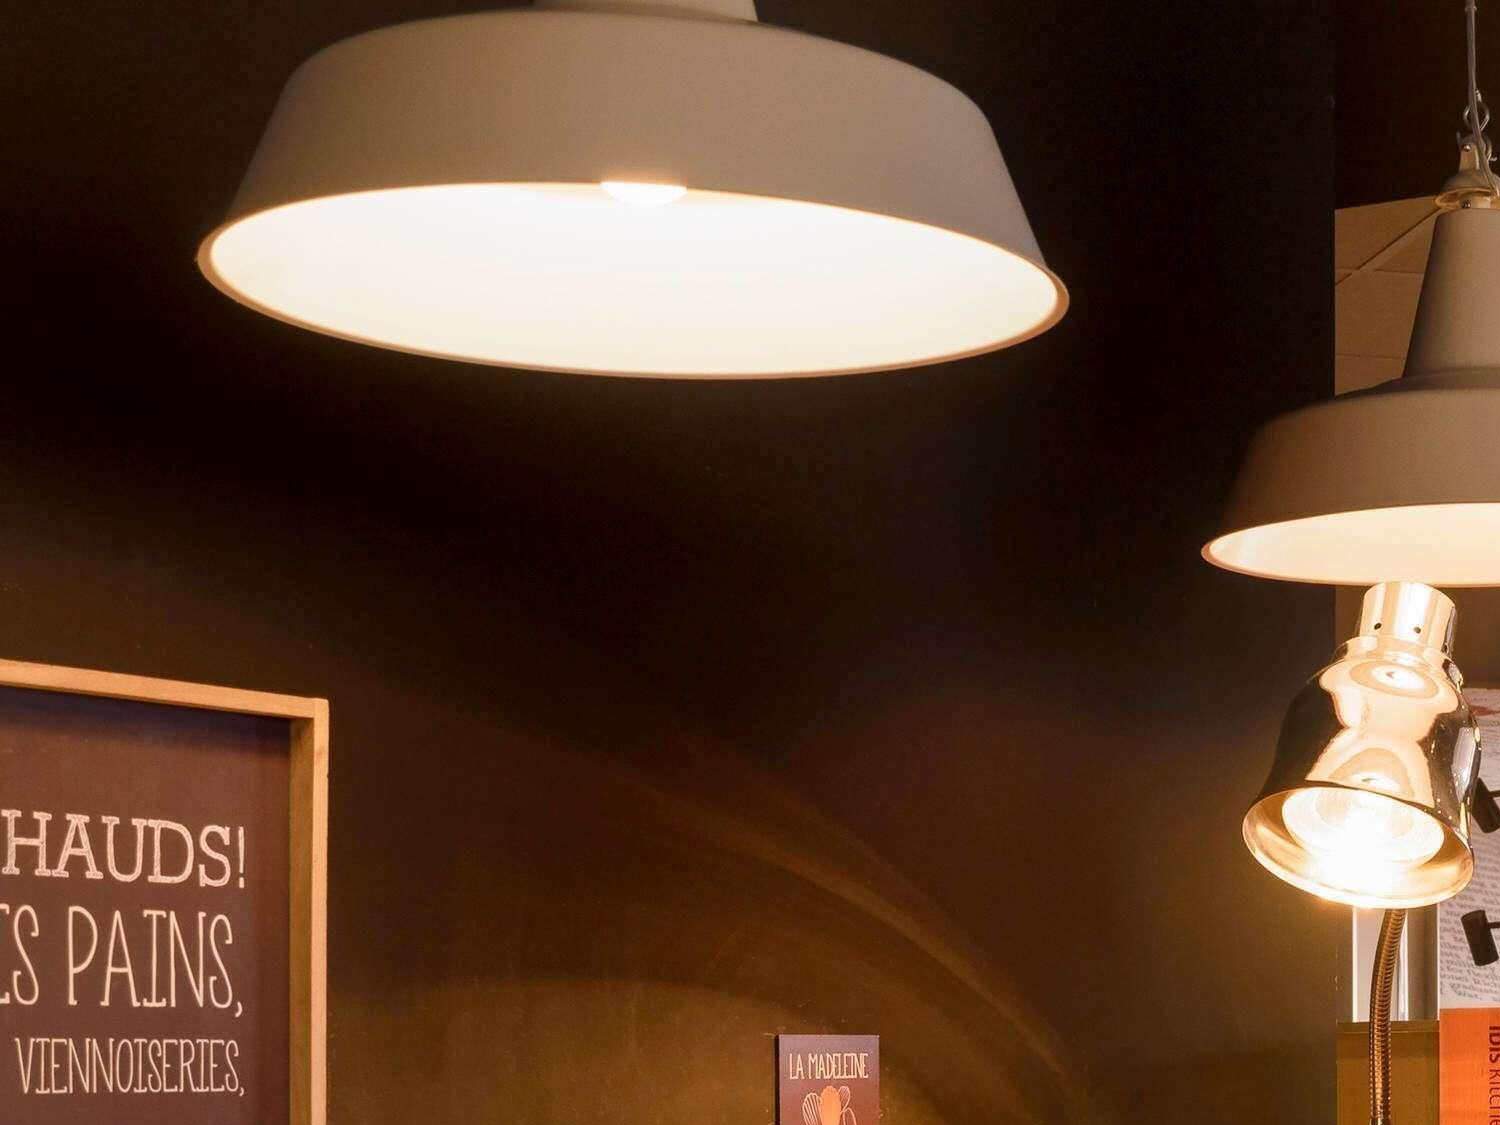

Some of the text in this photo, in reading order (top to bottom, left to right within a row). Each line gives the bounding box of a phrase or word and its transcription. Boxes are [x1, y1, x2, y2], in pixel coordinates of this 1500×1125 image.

[0, 808, 245, 888] HAUDS!
[67, 905, 243, 1018] PAINS,
[14, 1037, 244, 1097] VIENNOISERIES,
[789, 1052, 869, 1080] LA MADELEINE
